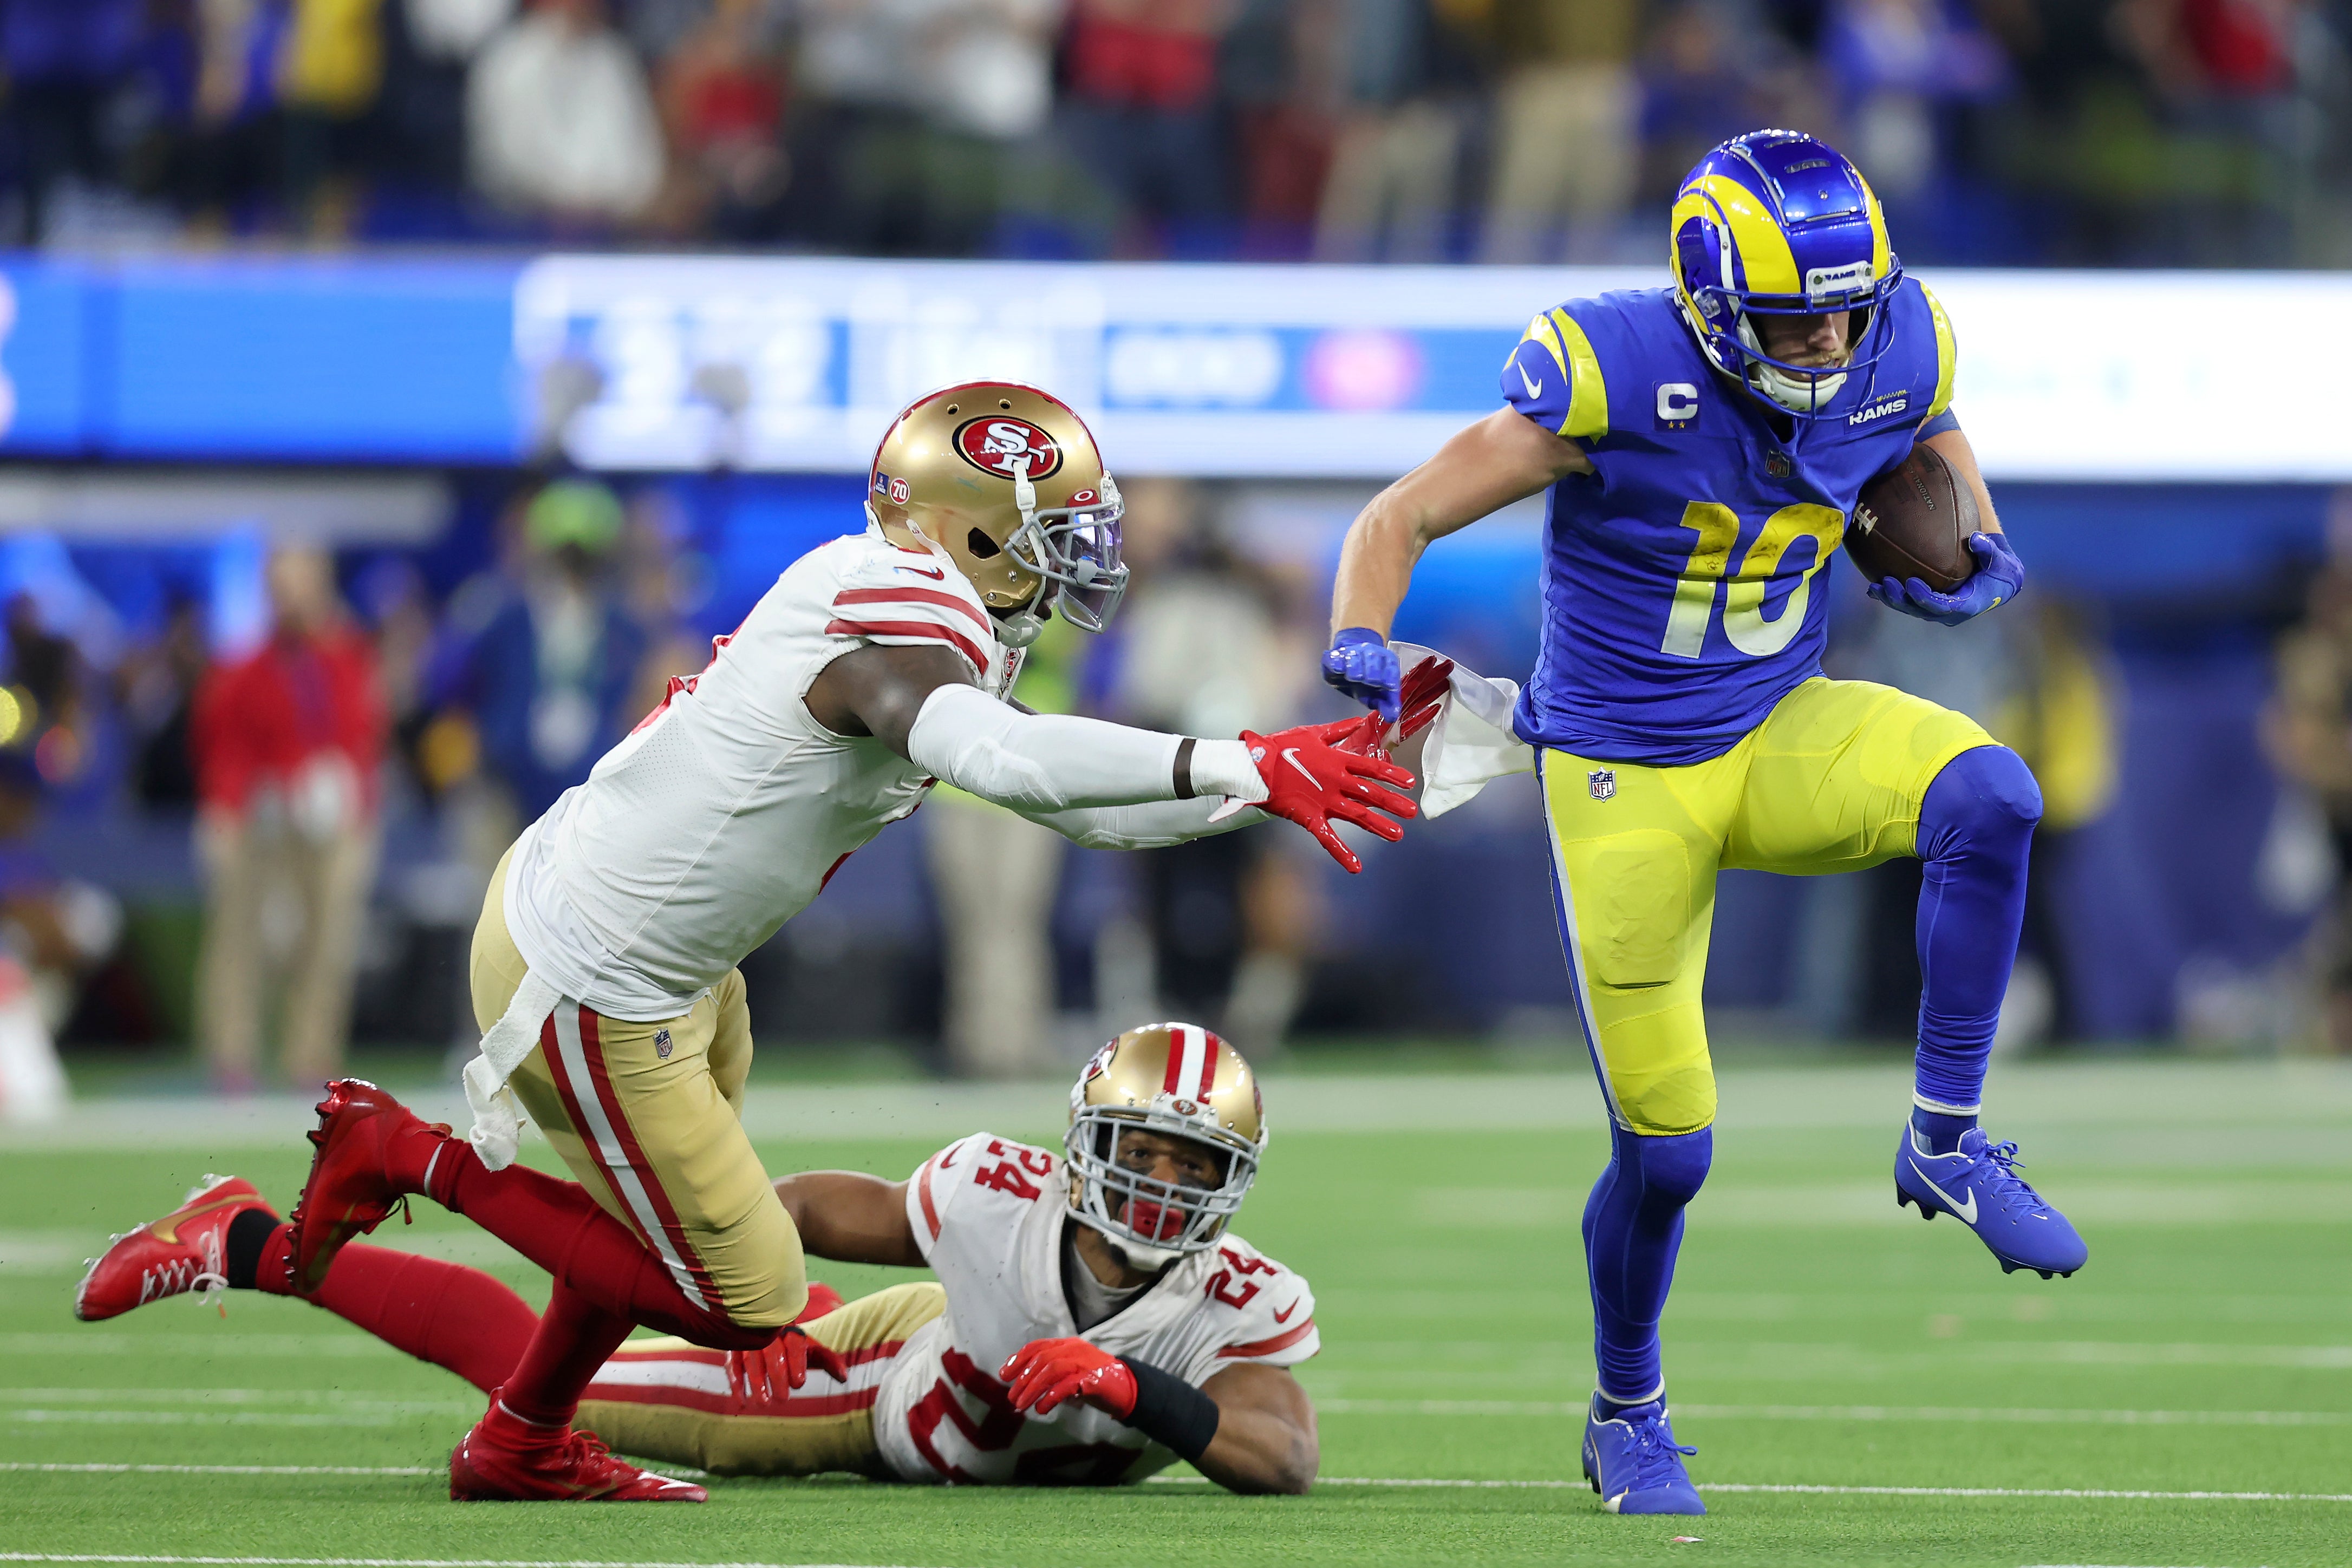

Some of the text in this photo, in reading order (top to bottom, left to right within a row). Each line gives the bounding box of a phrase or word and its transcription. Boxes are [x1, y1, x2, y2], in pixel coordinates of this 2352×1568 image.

[1657, 382, 1698, 420] C
[1849, 398, 1907, 426] RAMS
[892, 481, 908, 500] 70
[1913, 474, 1937, 512] NATIONAL
[1660, 500, 1845, 659] 10
[1593, 782, 1612, 796] NFL
[974, 1139, 1052, 1203] 24
[1204, 1246, 1279, 1310] 24
